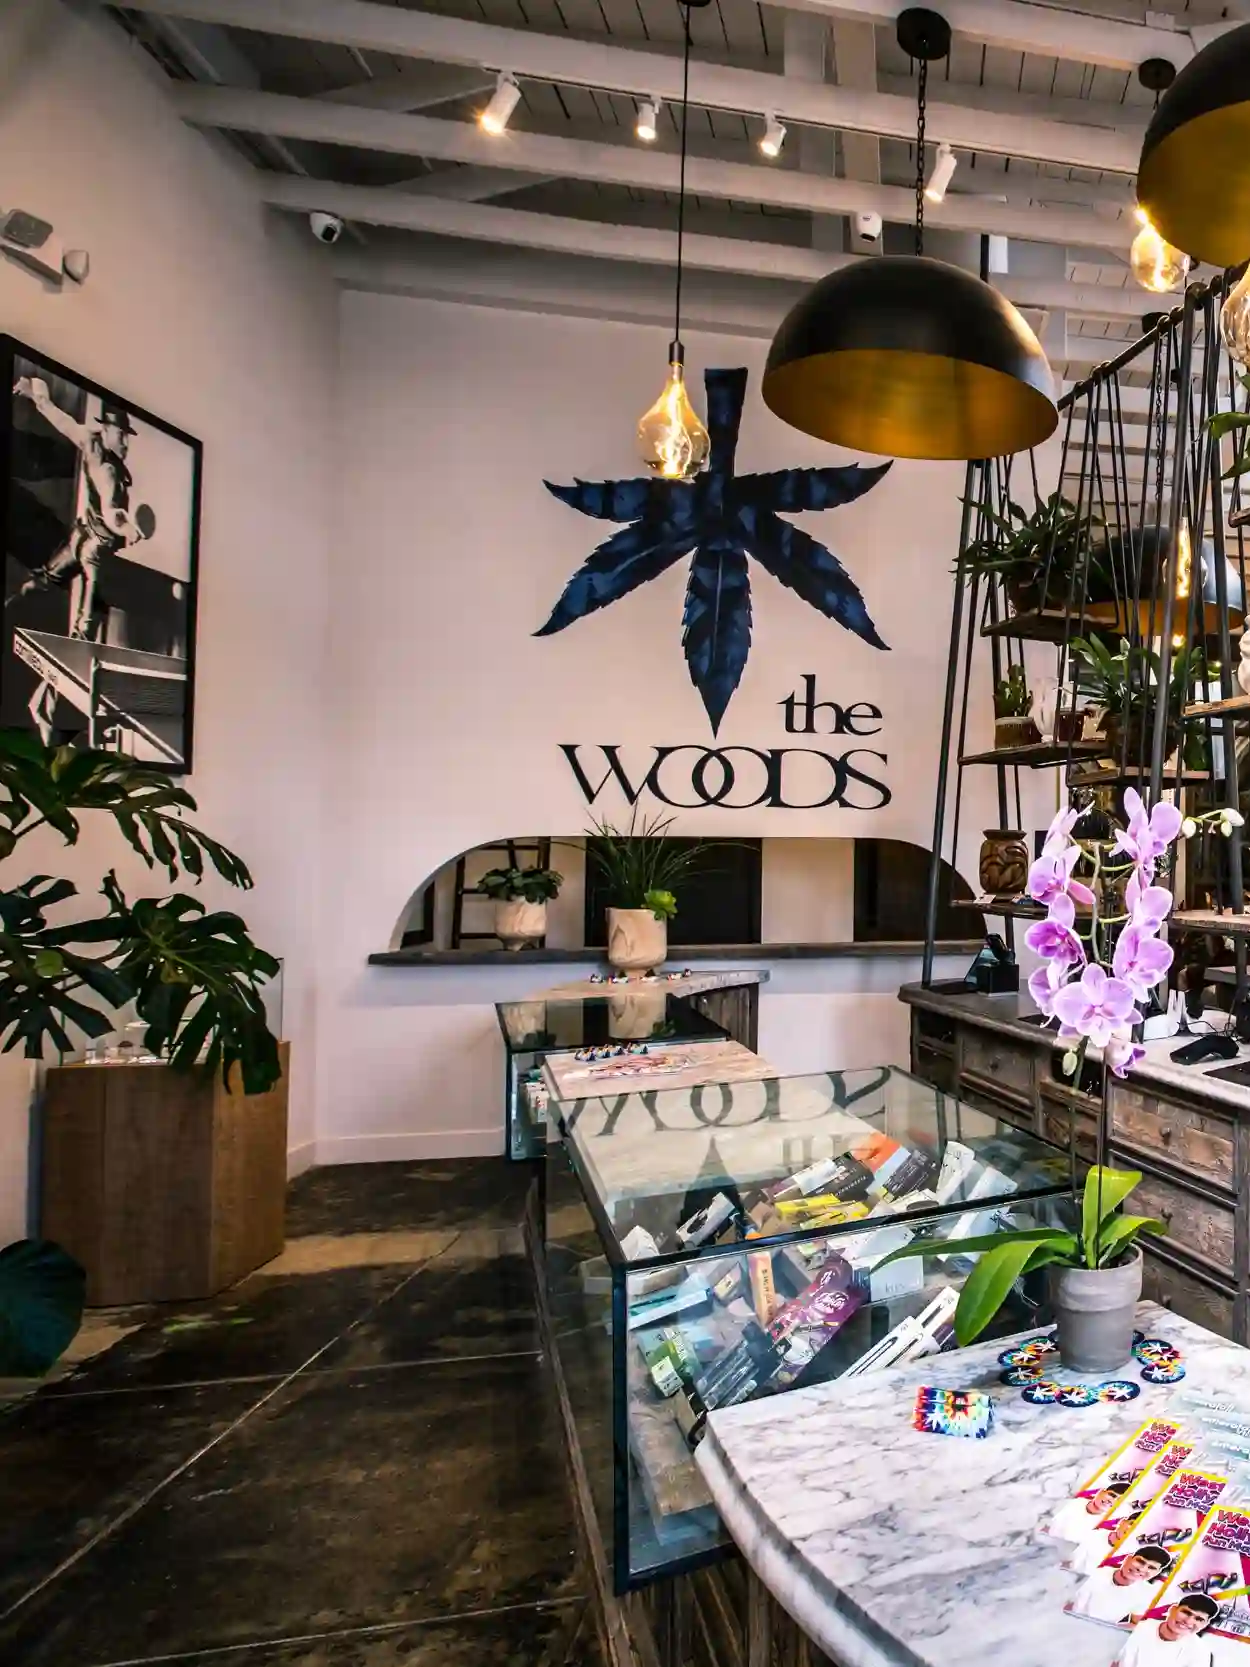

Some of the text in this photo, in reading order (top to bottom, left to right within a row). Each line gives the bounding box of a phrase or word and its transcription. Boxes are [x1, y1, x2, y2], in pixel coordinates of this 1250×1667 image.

[777, 674, 883, 736] the
[557, 744, 892, 810] WOODS
[1168, 1484, 1218, 1504] Holly
